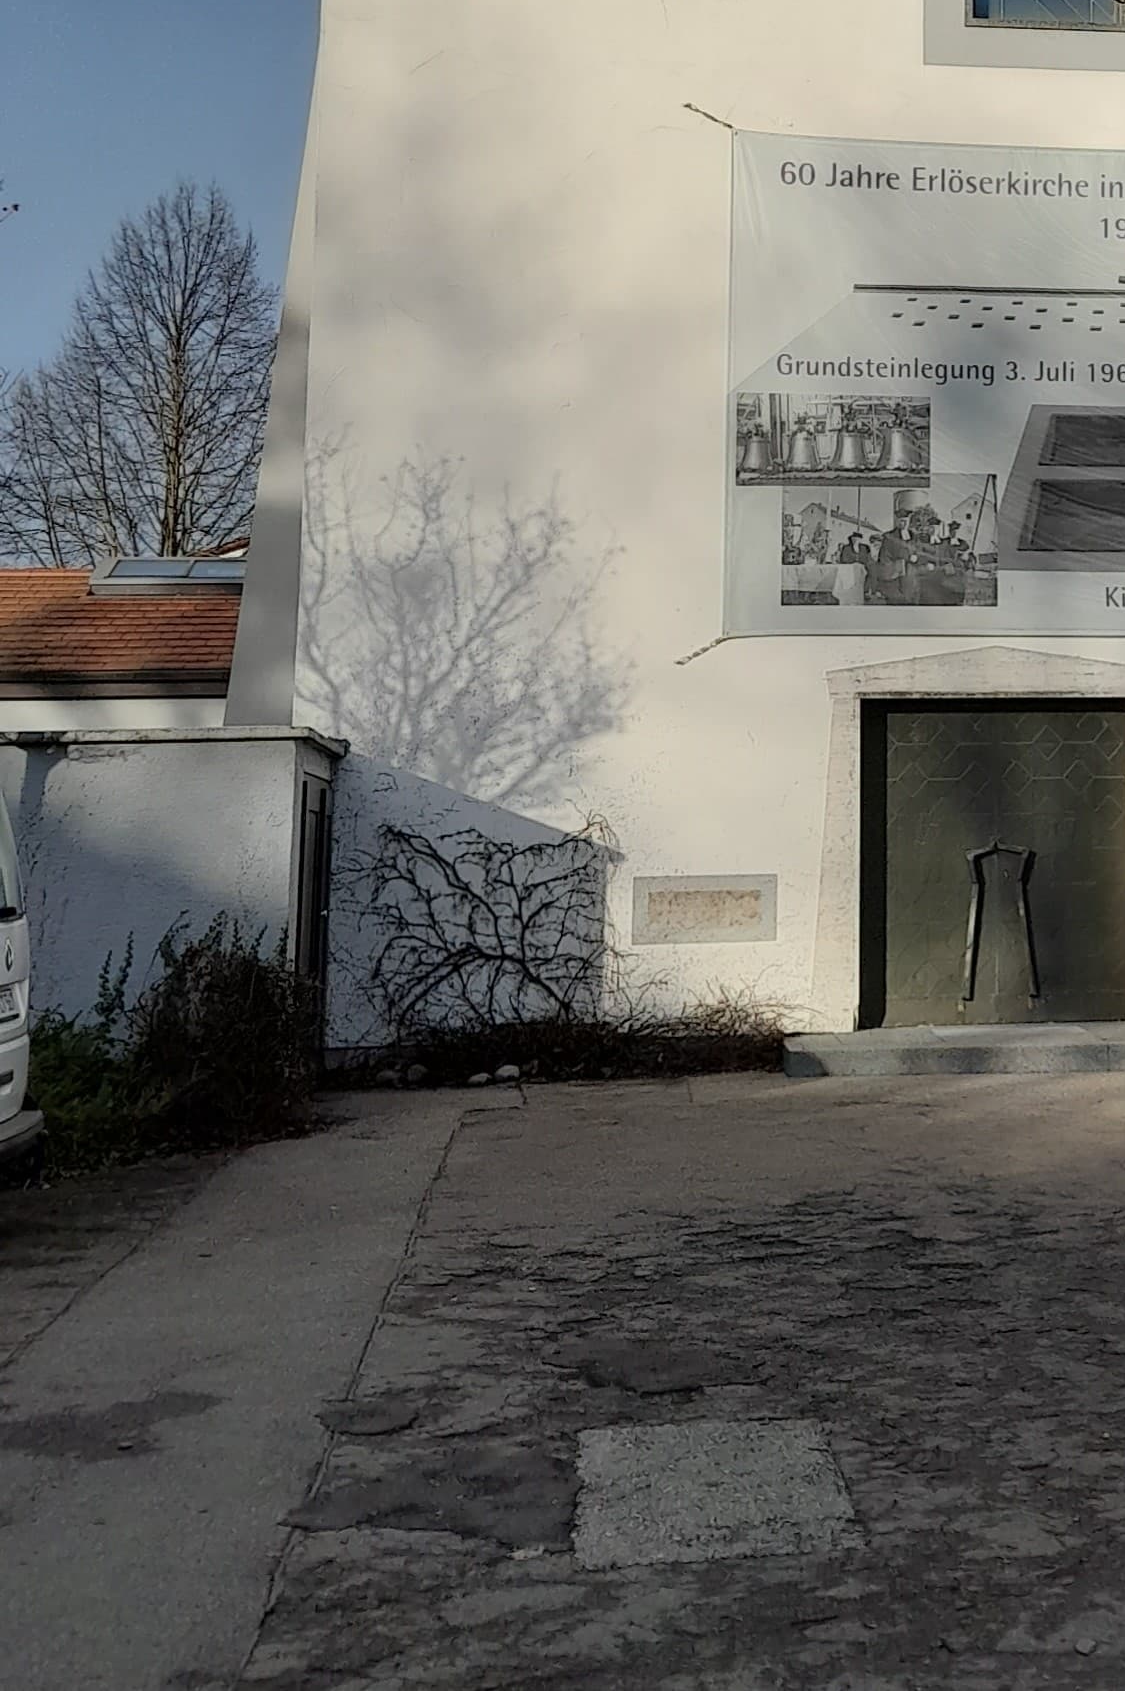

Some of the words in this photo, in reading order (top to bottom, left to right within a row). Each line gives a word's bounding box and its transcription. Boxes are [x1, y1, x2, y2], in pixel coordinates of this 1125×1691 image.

[780, 161, 816, 186] 60
[825, 162, 900, 191] Jahre
[912, 166, 1090, 198] Erlöserkirche
[1100, 174, 1124, 199] in
[776, 353, 996, 386] Grundsteinlegung
[1004, 360, 1026, 382] 3.
[1034, 359, 1075, 383] Juli
